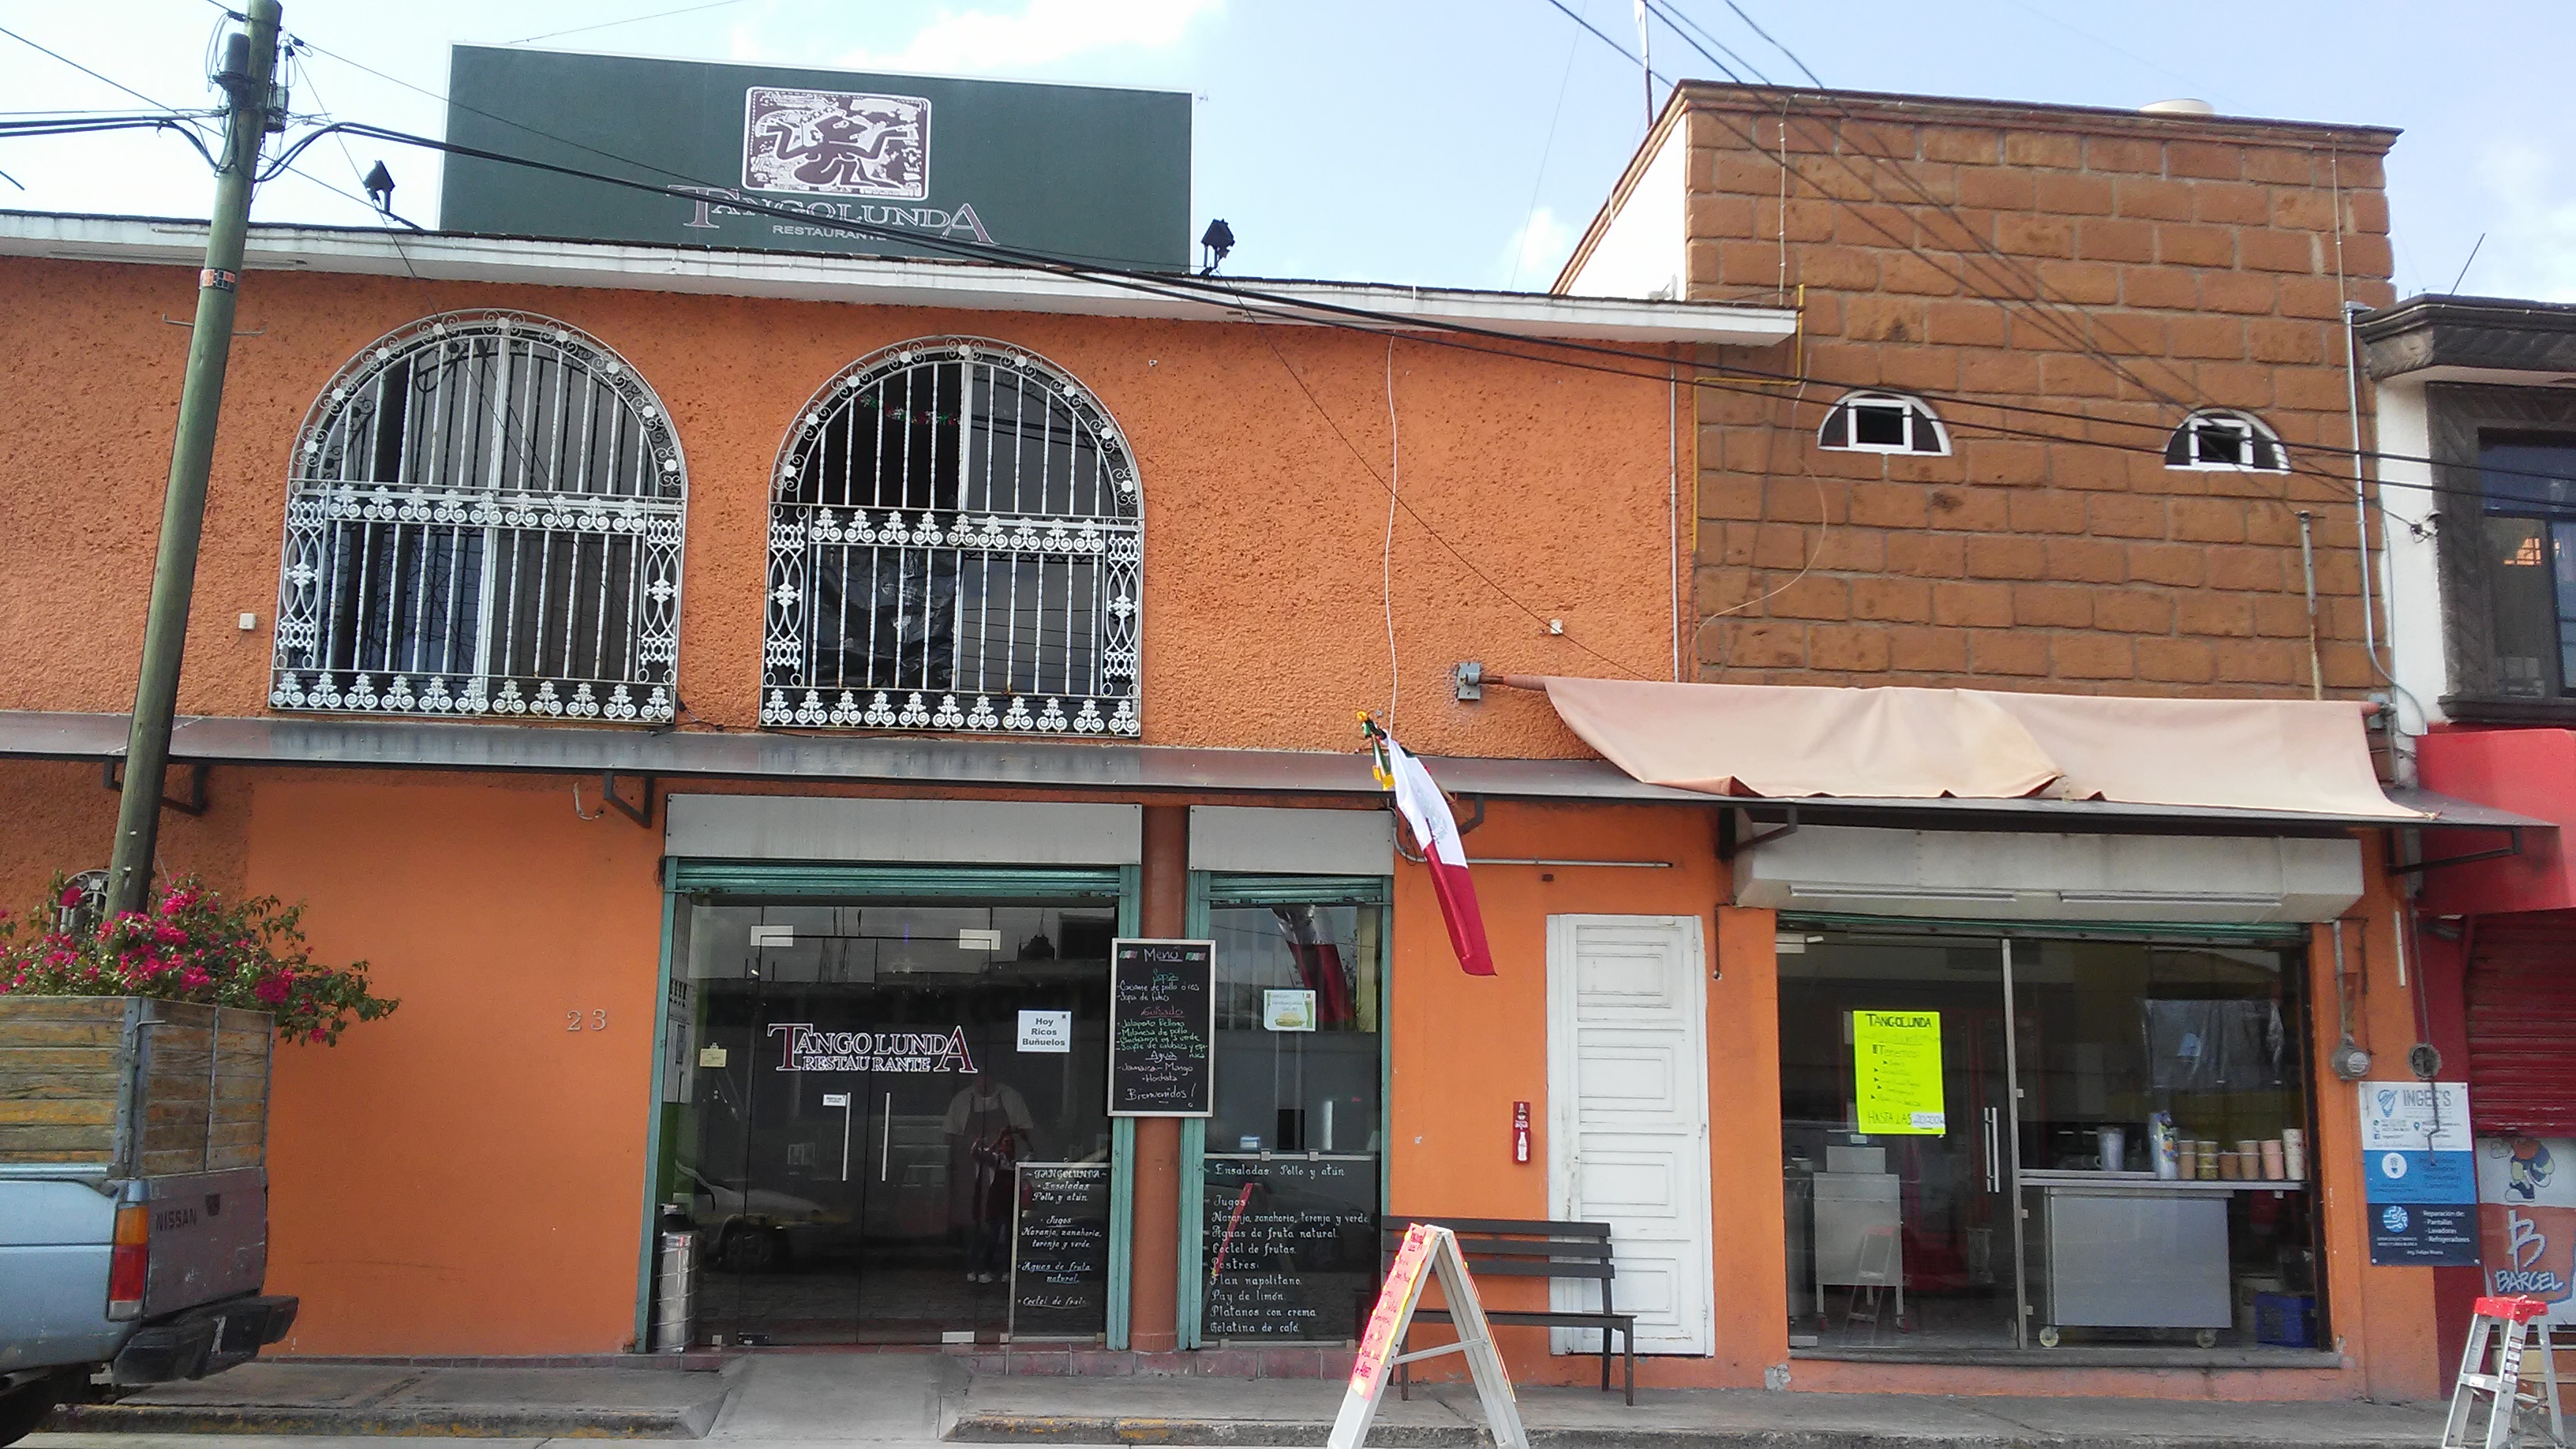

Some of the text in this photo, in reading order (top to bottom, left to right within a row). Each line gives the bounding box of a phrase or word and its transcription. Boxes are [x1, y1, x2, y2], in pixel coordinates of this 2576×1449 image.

[1035, 1018, 1054, 1027] Hoy
[1022, 1038, 1065, 1046] Buñuelos
[1280, 1164, 1304, 1175] Pollo
[1310, 1167, 1316, 1179] y
[1321, 1163, 1345, 1176] atún
[1043, 1181, 1090, 1190] Ensaladas
[1032, 1192, 1054, 1200] Pollo
[1067, 1193, 1088, 1201] atún
[156, 1208, 197, 1231] NISSAN
[1046, 1215, 1072, 1225] Jugos
[1254, 1211, 1297, 1223] zanahoria,
[1301, 1211, 1331, 1226] toronja
[1335, 1215, 1342, 1226] y
[1061, 1228, 1102, 1237] zanahoria,
[1211, 1225, 1246, 1241] Aguas
[1251, 1227, 1262, 1238] de
[1267, 1226, 1294, 1240] fruta
[1032, 1239, 1059, 1250] toronja
[1061, 1241, 1068, 1250] y
[1212, 1242, 1297, 1256] Coctel de frutas.
[1022, 1261, 1051, 1272] Aguas
[1068, 1262, 1090, 1272] fruta
[1210, 1273, 1302, 1289] Flan napolitano.
[2494, 1268, 2565, 1293] BARCEL
[1023, 1295, 1048, 1305] Coctel
[1052, 1295, 1061, 1305] de
[1211, 1289, 1233, 1305] Pay
[1238, 1290, 1249, 1301] de
[1266, 1308, 1282, 1316] con
[1210, 1320, 1255, 1334] Gelatina
[1261, 1321, 1272, 1333] de
